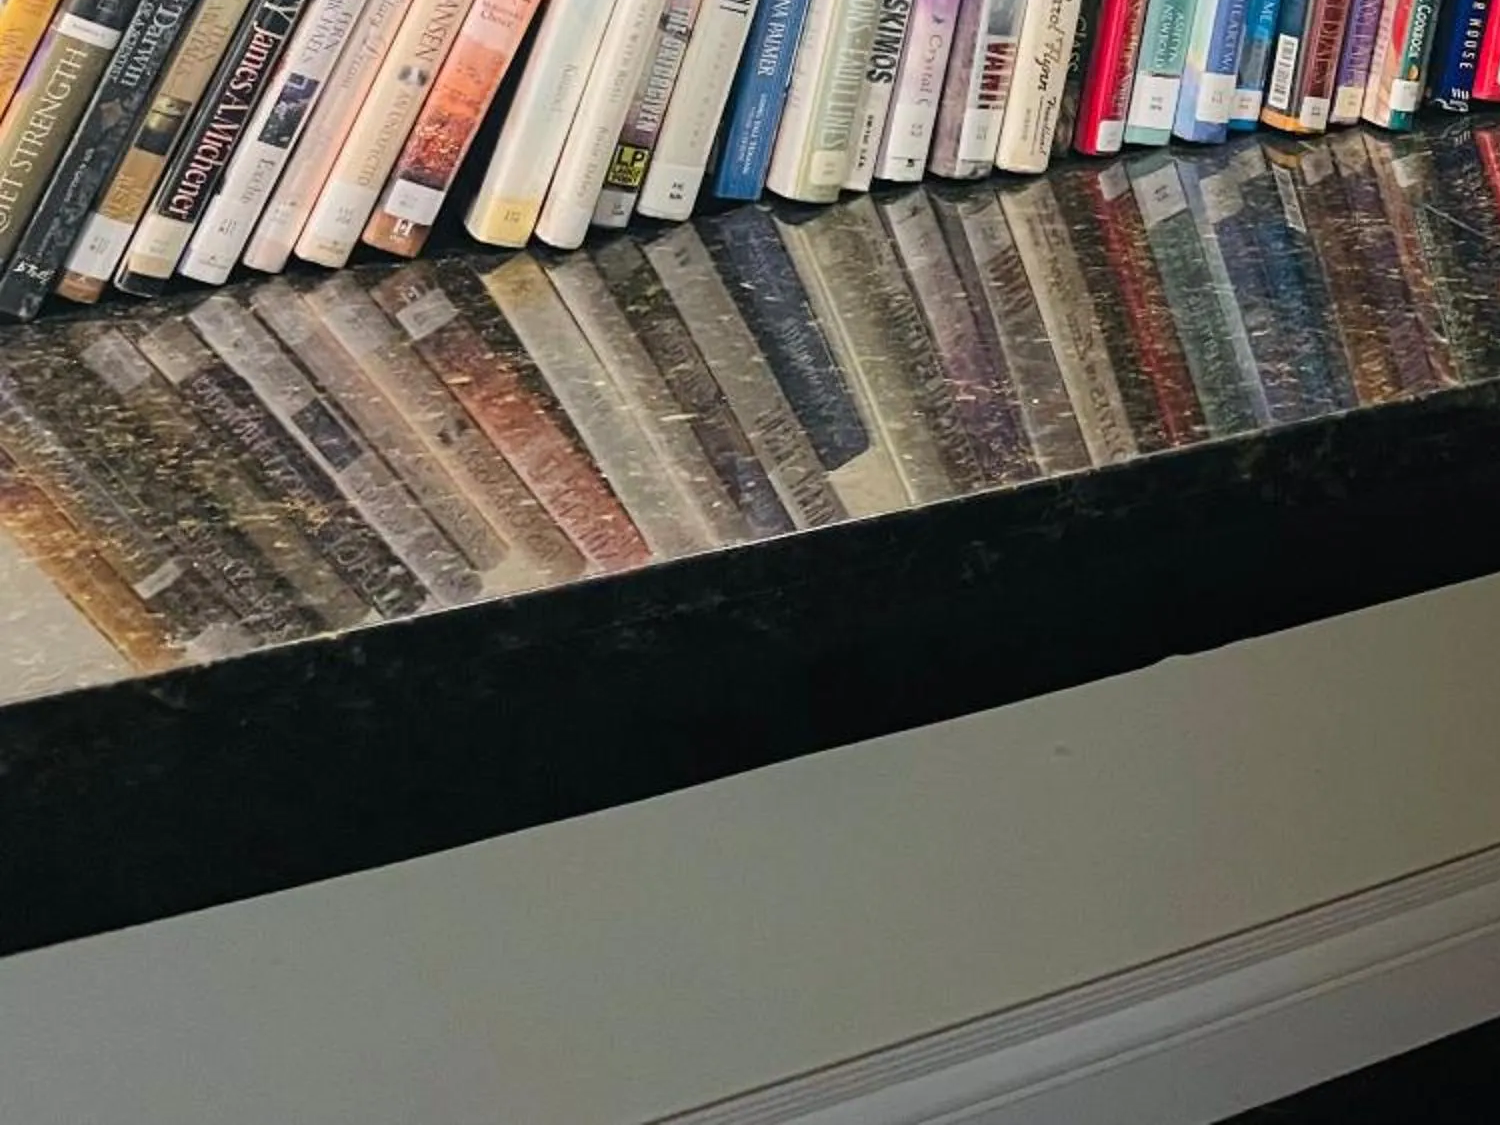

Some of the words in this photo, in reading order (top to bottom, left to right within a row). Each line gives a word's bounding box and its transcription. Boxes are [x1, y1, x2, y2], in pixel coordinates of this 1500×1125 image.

[119, 4, 179, 91] Darwin
[226, 20, 285, 96] James
[756, 21, 786, 77] PALMER
[977, 38, 1016, 112] VANI
[1024, 33, 1063, 93] Flynn
[1458, 18, 1483, 70] HOUSE
[10, 47, 88, 172] STRENGTH
